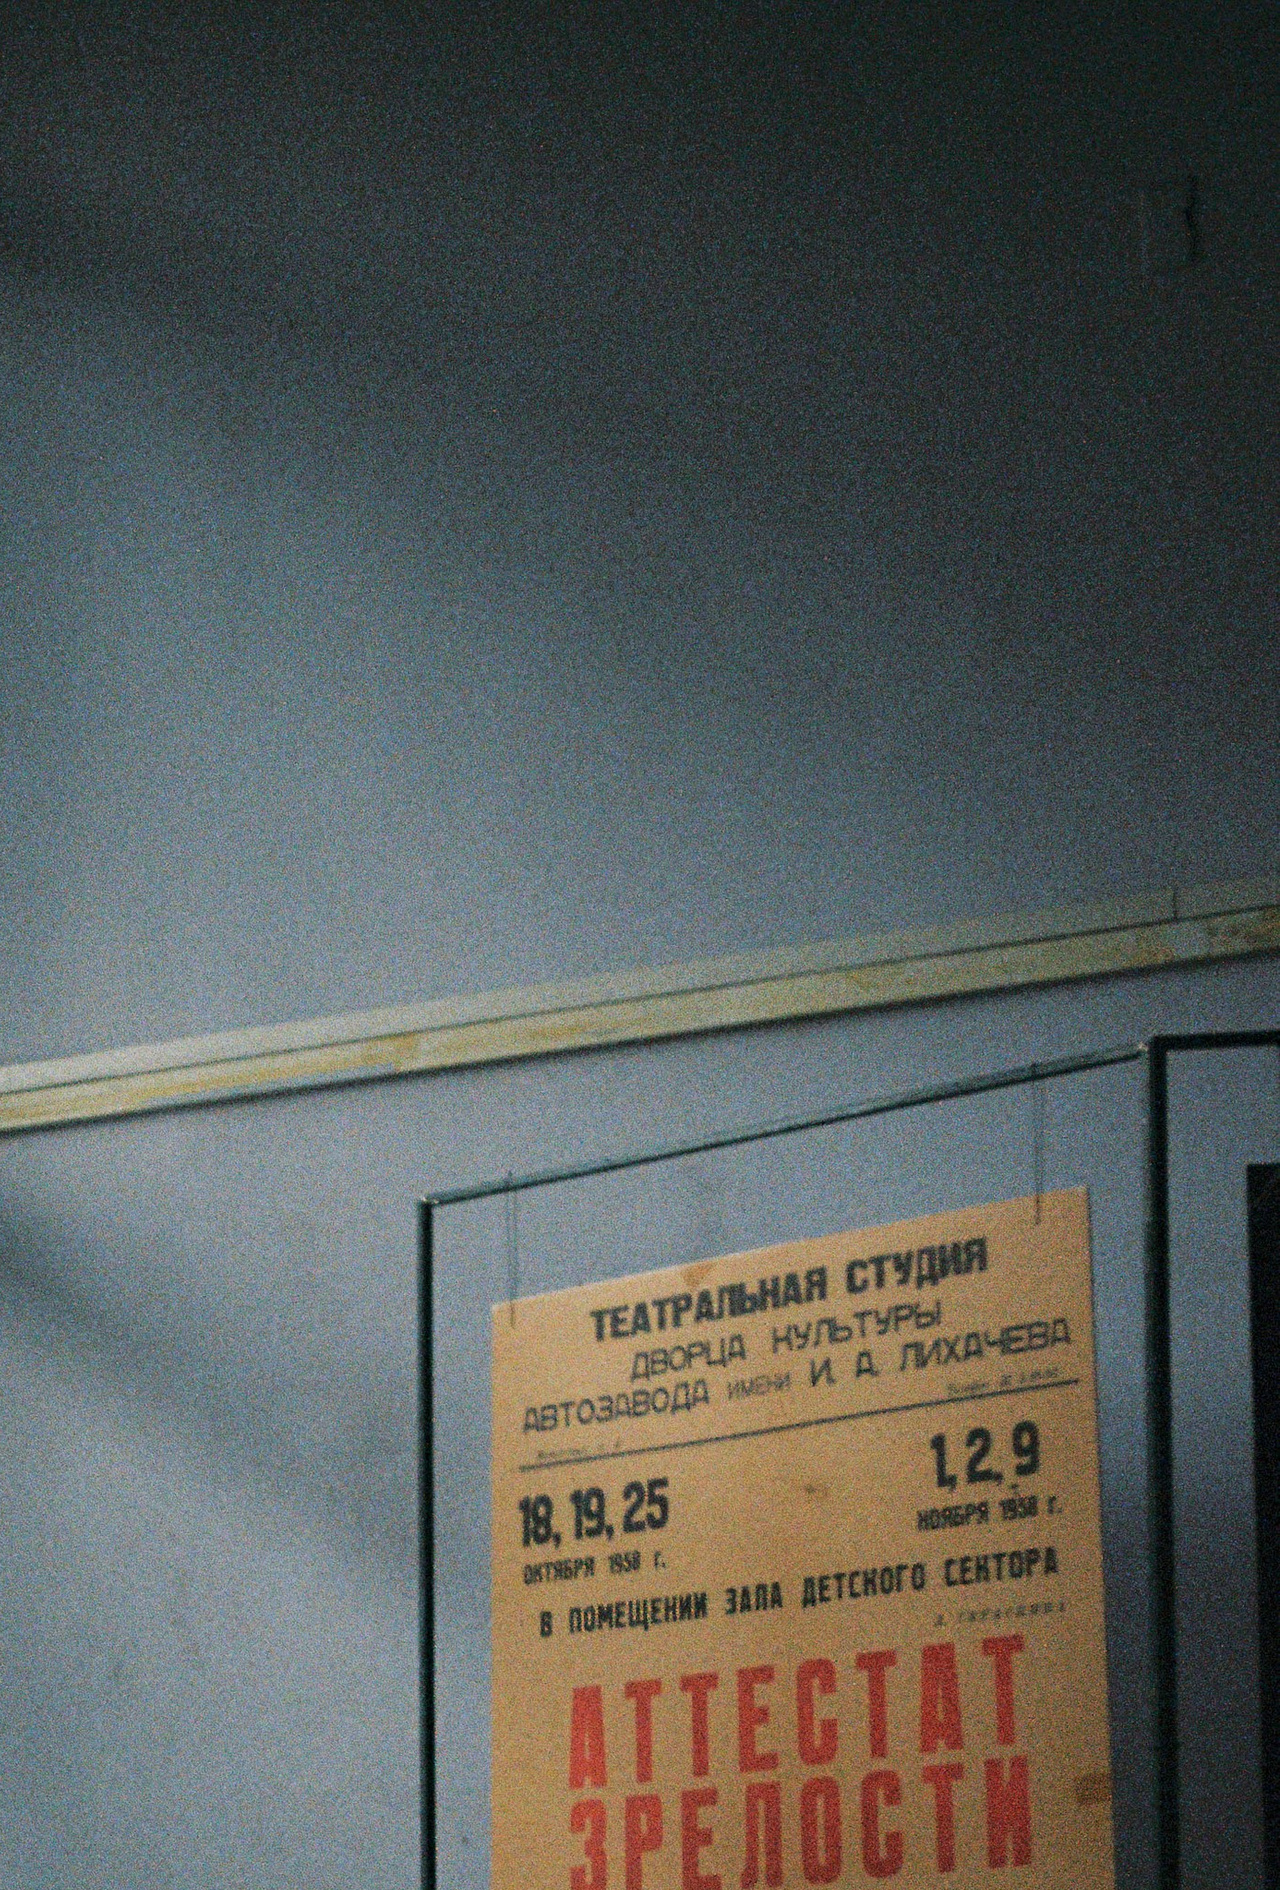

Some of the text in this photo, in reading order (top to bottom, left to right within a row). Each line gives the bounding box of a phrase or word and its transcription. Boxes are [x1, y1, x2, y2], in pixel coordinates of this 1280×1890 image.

[590, 1236, 988, 1342] ТЕАТРАЛЬНАЯ СТУДИЯ
[523, 1379, 710, 1433] АВТОЗАВОДА
[899, 1317, 1071, 1372] ЛИХАЧЕВА
[631, 1300, 942, 1382] ДВОРЦА КУЛЬТУРЫ
[1011, 1419, 1040, 1477] 9
[519, 1477, 669, 1548] 18, 19, 25
[569, 1591, 709, 1634] ПОМЕЩЕНИИ
[726, 1581, 783, 1615] ЗАЛА
[801, 1562, 925, 1610] ДЕТСКОГО
[943, 1546, 1059, 1588] СЕКТОРА
[568, 1634, 1025, 1789] АТТЕСТАТ
